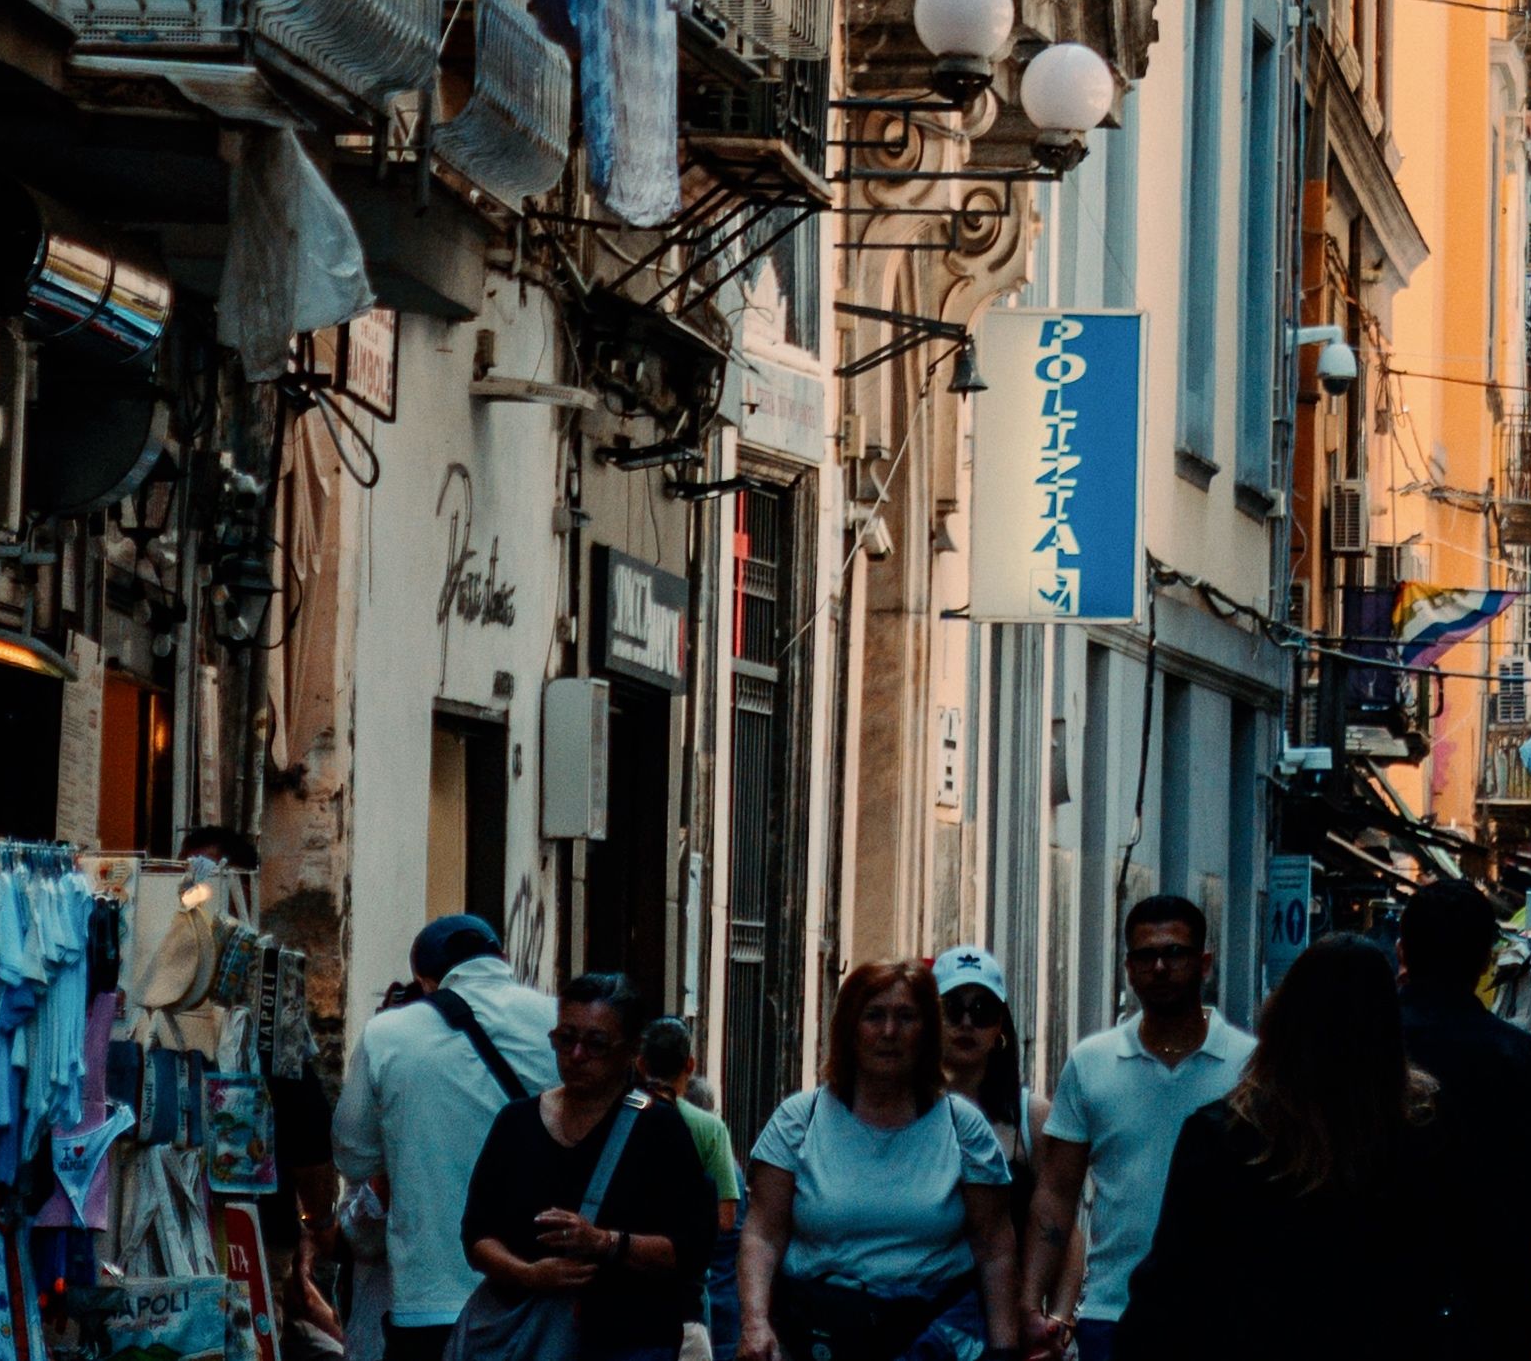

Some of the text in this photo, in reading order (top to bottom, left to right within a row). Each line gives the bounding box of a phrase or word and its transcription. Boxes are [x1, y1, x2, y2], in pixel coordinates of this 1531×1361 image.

[1033, 318, 1087, 557] POLIZIA
[258, 973, 277, 1054] NAPOLI
[110, 1290, 190, 1320] APOLI
